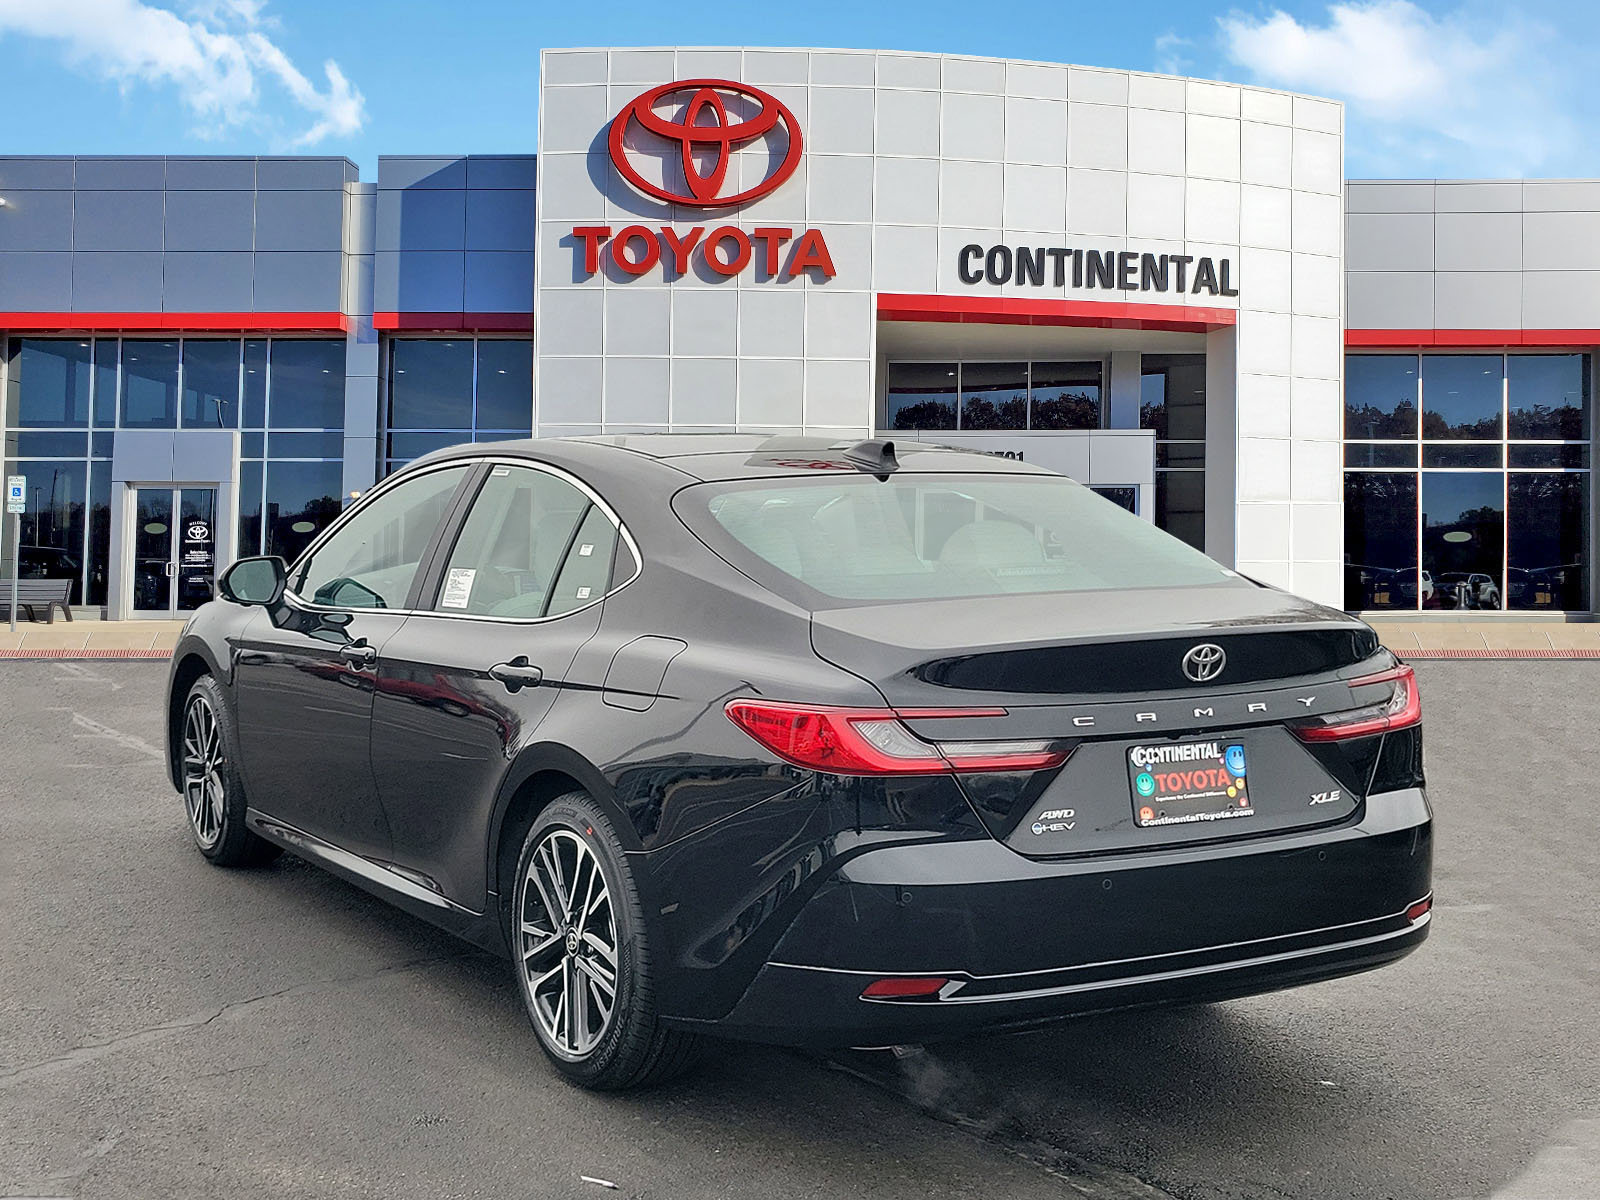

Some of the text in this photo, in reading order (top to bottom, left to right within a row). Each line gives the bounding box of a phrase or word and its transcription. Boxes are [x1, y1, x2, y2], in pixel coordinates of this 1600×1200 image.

[572, 224, 837, 277] TOYOTA
[959, 243, 1239, 297] CONTINENTAL
[1073, 696, 1316, 726] CAMRY
[1131, 743, 1221, 767] CONTINENTAL
[1154, 768, 1232, 792] TOYOTA
[1309, 790, 1341, 806] XLE
[1038, 809, 1075, 821] AWD
[1141, 809, 1254, 827] ContinentalToyota.com
